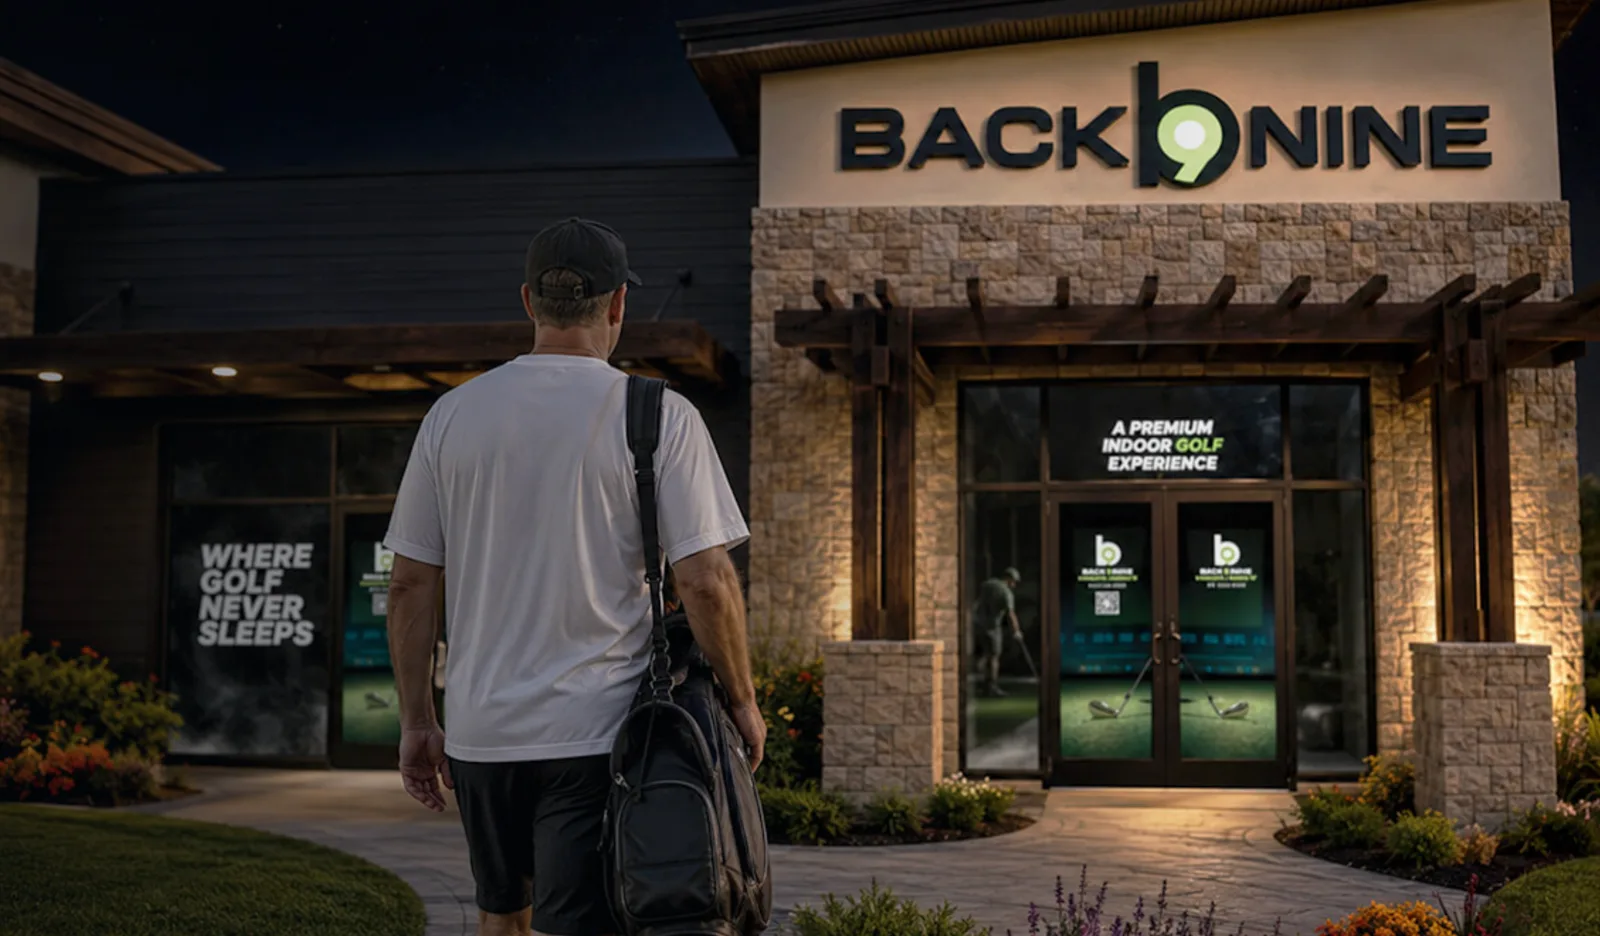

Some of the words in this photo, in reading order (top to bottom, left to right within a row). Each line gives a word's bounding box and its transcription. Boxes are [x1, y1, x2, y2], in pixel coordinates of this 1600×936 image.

[838, 105, 1130, 170] BACK
[1249, 104, 1493, 169] NINE
[1111, 420, 1126, 436] A
[1129, 419, 1214, 436] PREMIUM
[1102, 437, 1173, 453] INDOOR
[1175, 437, 1224, 453] GOLF
[1107, 455, 1219, 471] EXPERIENCE
[201, 543, 314, 569] WHERE
[200, 568, 285, 595] GOLF
[199, 594, 305, 621] NEVER
[197, 620, 315, 647] SLEEPS
